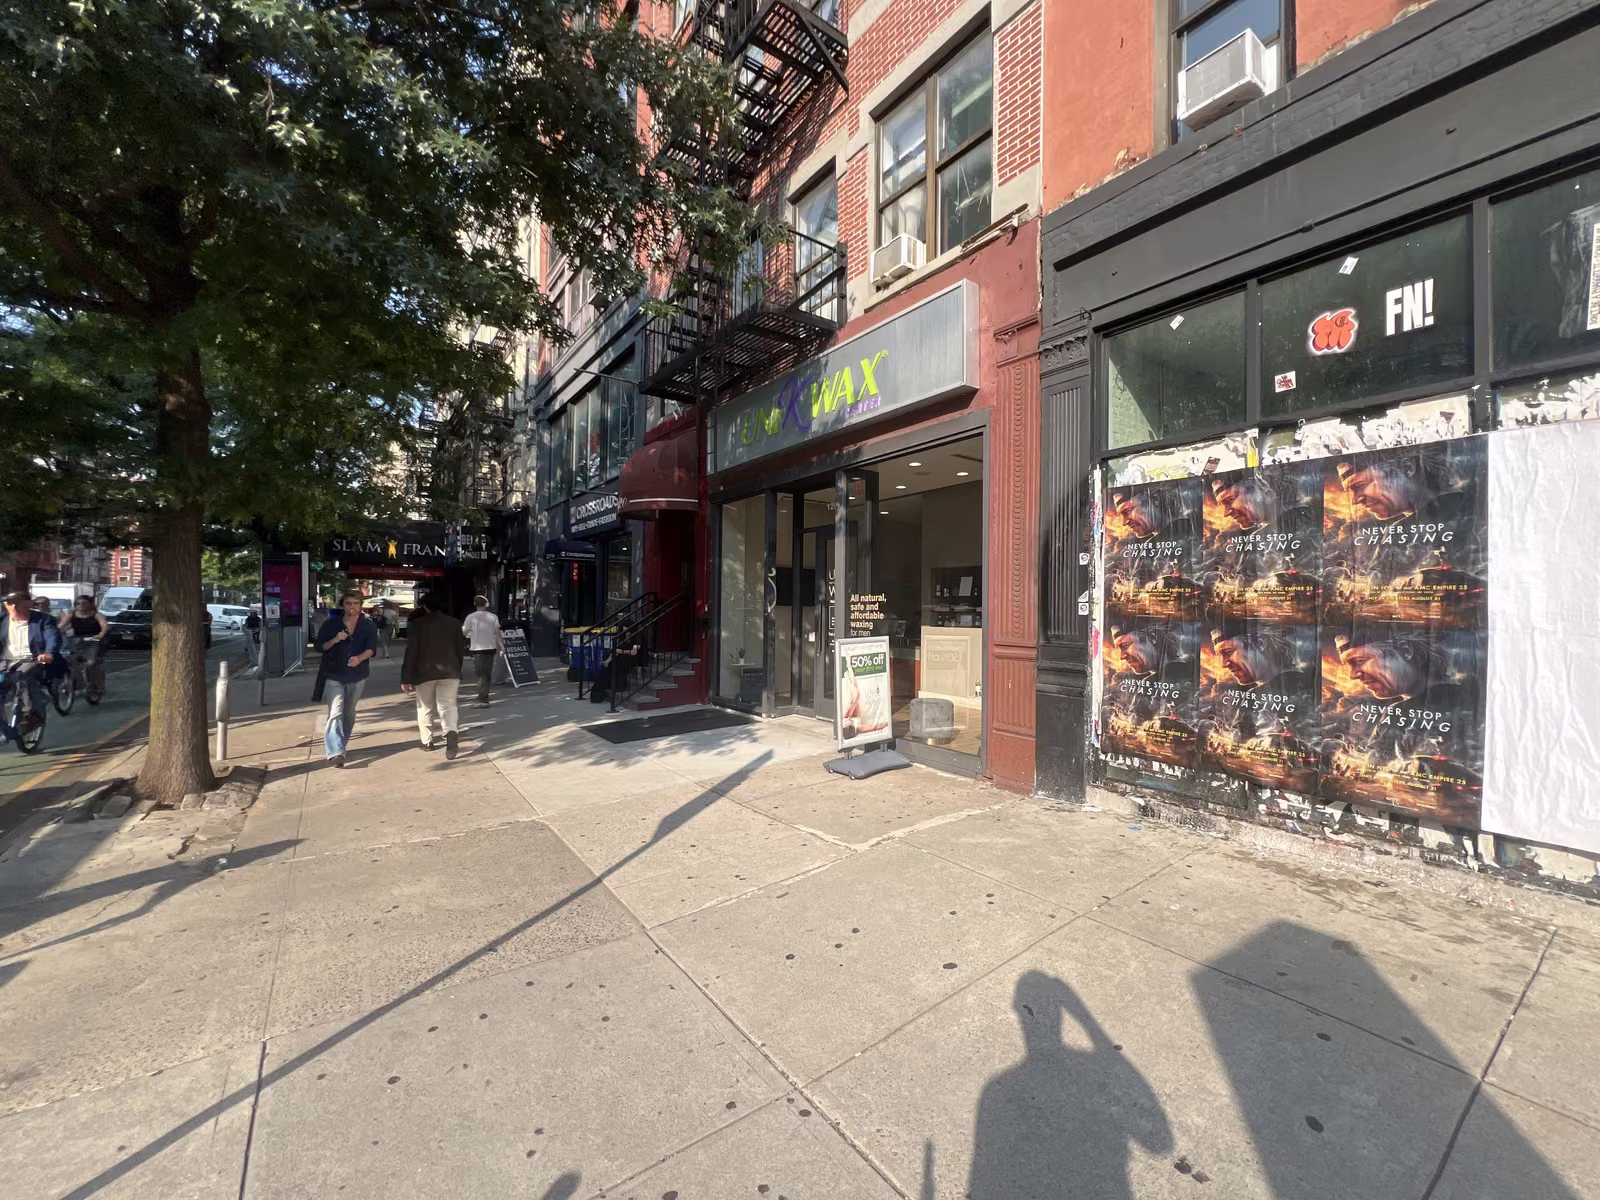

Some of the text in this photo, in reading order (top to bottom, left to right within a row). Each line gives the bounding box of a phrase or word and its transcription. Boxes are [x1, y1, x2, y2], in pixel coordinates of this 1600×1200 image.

[1386, 278, 1434, 336] FN!
[1362, 524, 1444, 536] NEVER STOP
[1231, 533, 1294, 544] NEVER STOP
[1354, 532, 1454, 546] CHASING
[332, 539, 446, 556] SLAM FRAN
[1128, 541, 1177, 550] NEVER STOP
[1226, 540, 1301, 554] CHASING
[1123, 547, 1183, 558] CHASING
[850, 593, 887, 602] All natural,
[850, 602, 879, 610] safe and
[850, 620, 874, 630] waxing
[851, 653, 885, 668] 50% off
[1125, 678, 1174, 690] NEVER STOP
[1120, 685, 1180, 698] CHASING
[1228, 689, 1288, 703] NEVER STOP
[1222, 696, 1295, 713] CHASING
[1360, 704, 1442, 720] NEVER STOP
[1352, 712, 1451, 732] CHASING
[1429, 774, 1454, 784] EMPIRE
